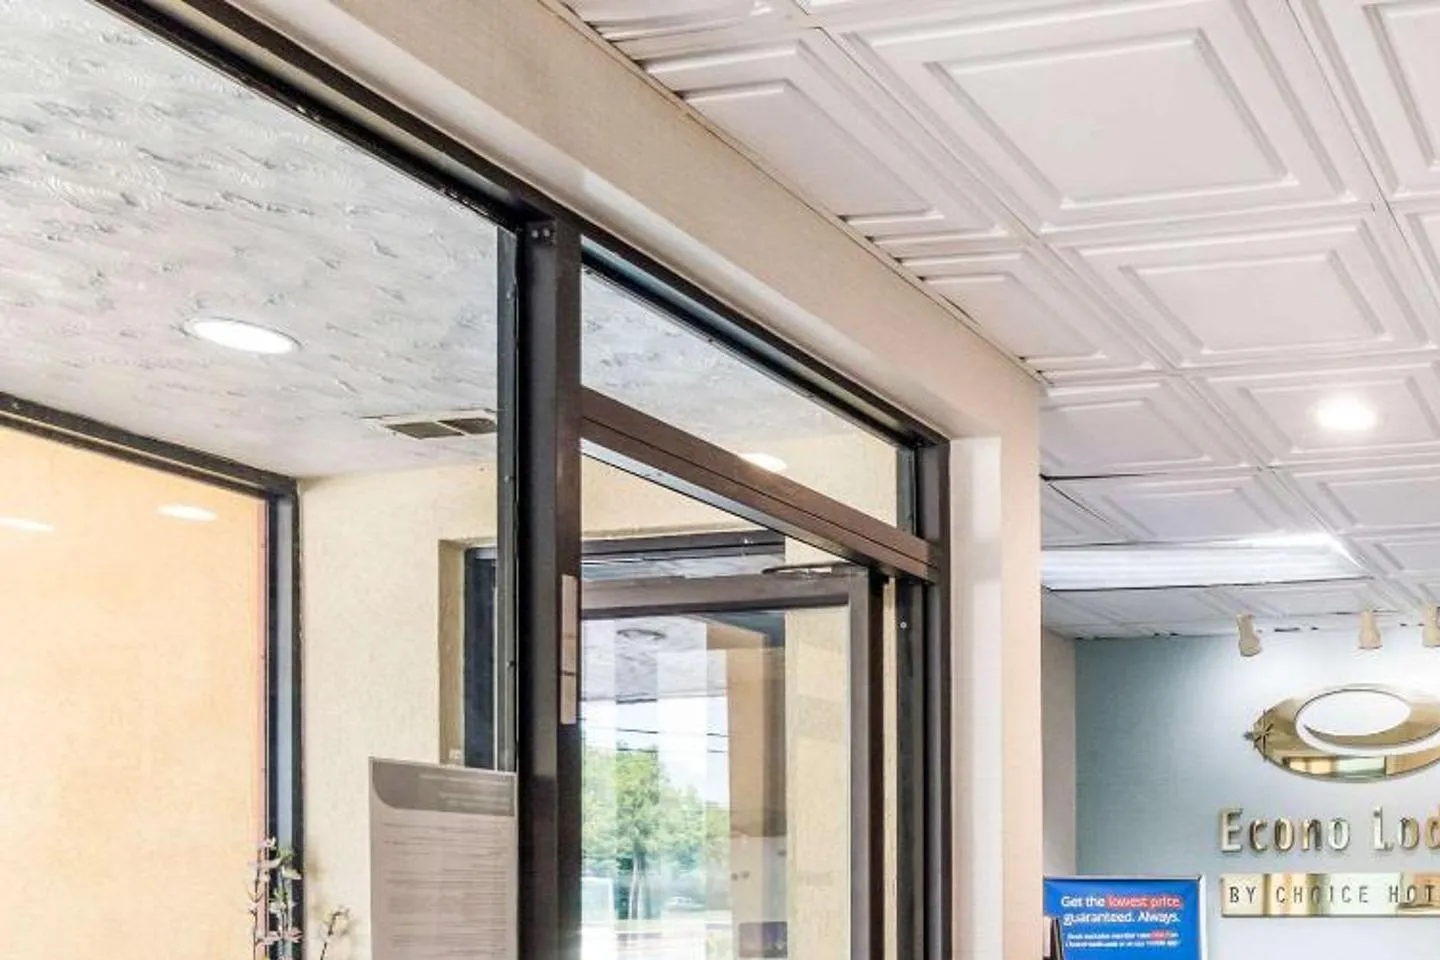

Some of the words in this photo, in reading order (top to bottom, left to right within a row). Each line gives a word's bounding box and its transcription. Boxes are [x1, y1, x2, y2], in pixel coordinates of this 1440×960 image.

[1220, 805, 1351, 852] Econo
[1061, 895, 1082, 907] Get
[1086, 895, 1105, 907] the
[1108, 894, 1148, 908] lowest
[1229, 887, 1256, 903] BY
[1275, 886, 1369, 903] CHOICE
[1063, 912, 1136, 926] guaranteed.
[1138, 911, 1181, 925] Always.
